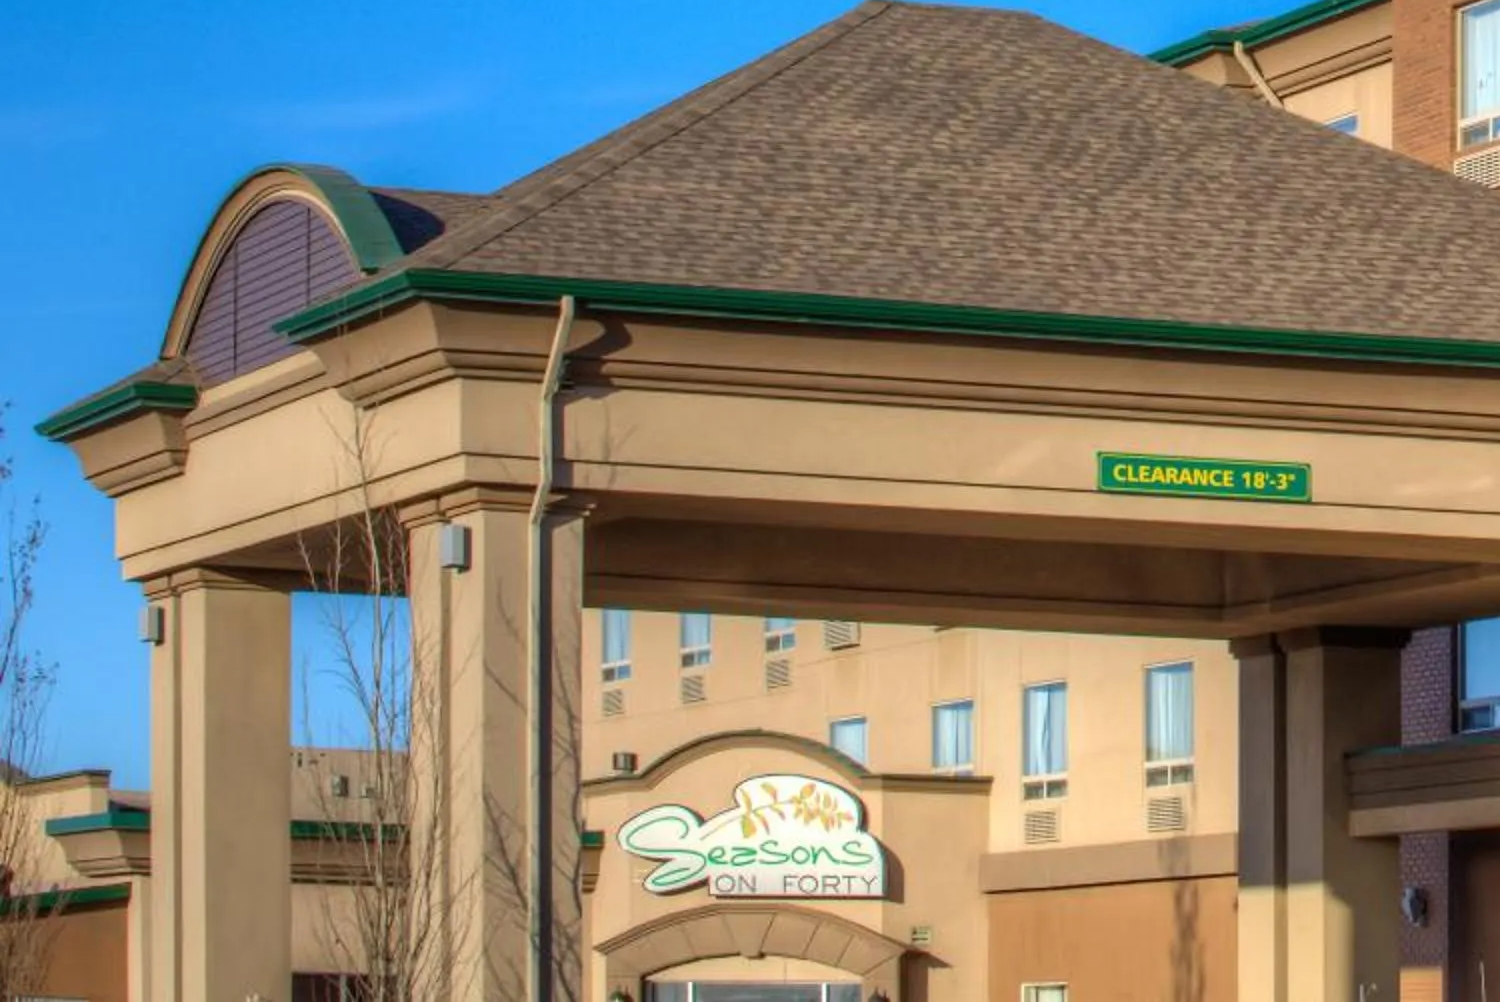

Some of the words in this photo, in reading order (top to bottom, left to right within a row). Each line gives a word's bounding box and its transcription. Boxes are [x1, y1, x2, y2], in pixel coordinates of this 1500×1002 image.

[1112, 464, 1234, 487] CLEARANCE
[715, 875, 757, 893] ON
[783, 876, 878, 894] FORTY
